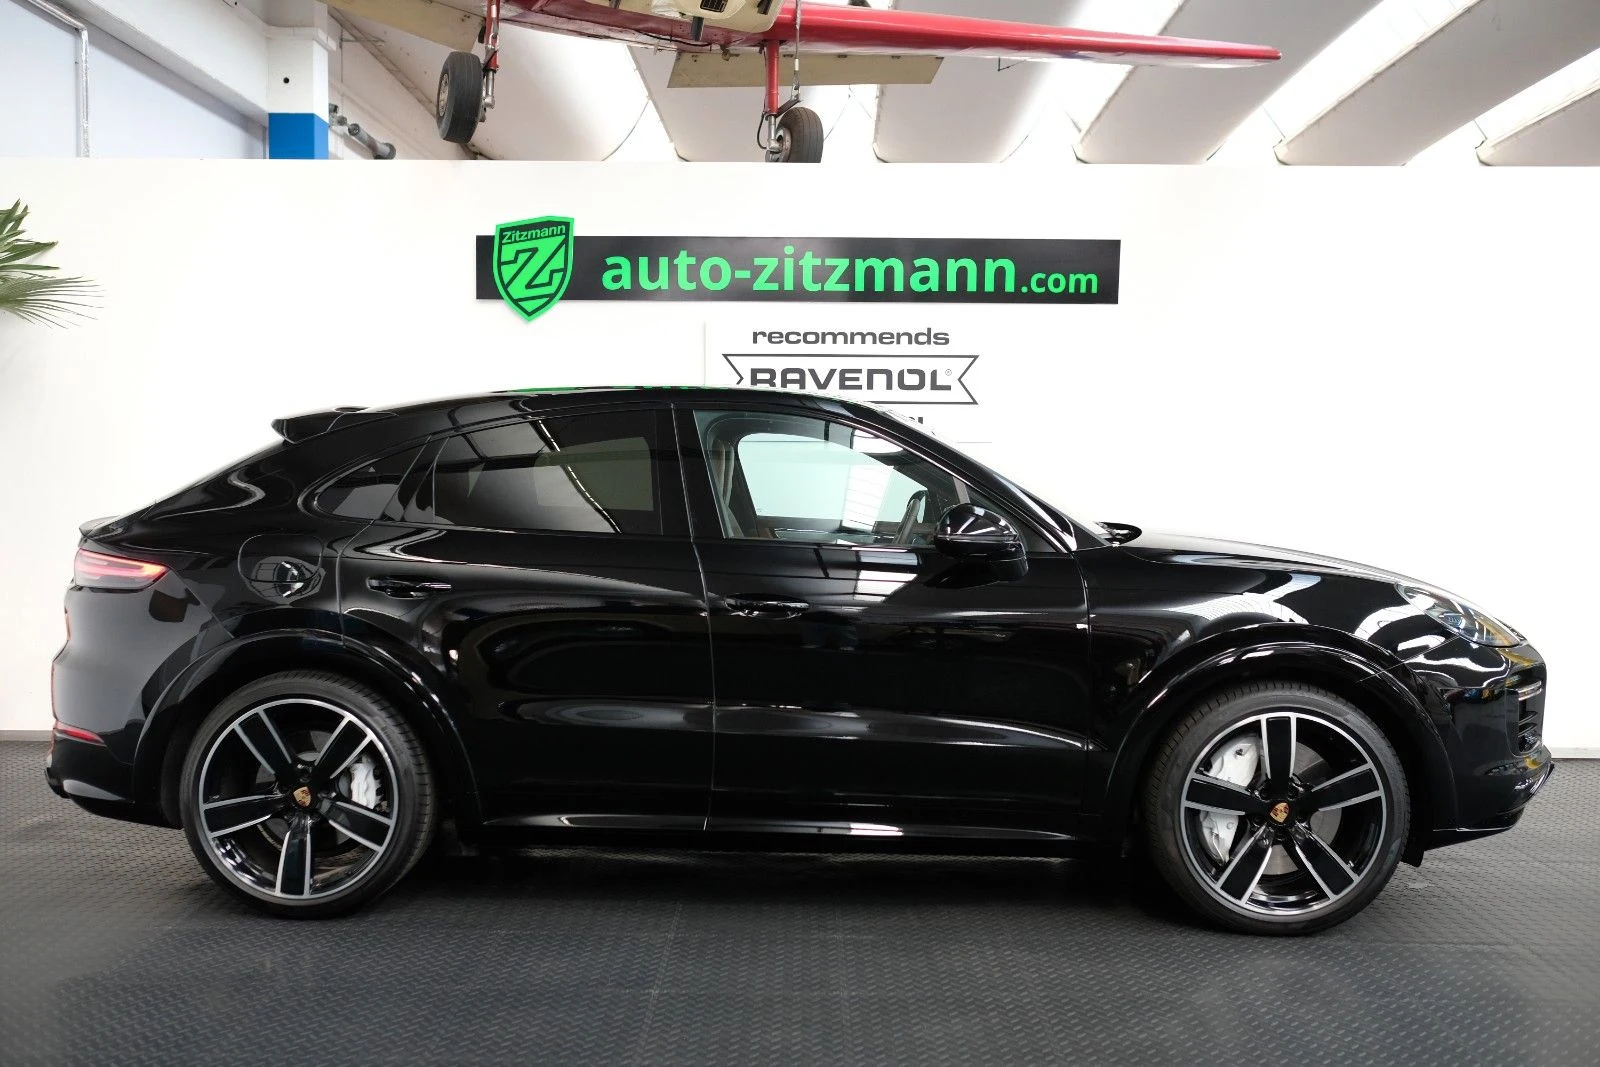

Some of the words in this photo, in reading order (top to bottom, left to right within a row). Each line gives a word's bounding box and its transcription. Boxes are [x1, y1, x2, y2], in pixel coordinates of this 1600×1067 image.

[502, 224, 566, 244] Zitzmann
[601, 246, 1099, 294] auto-zitzmann.com
[752, 327, 950, 346] recommends
